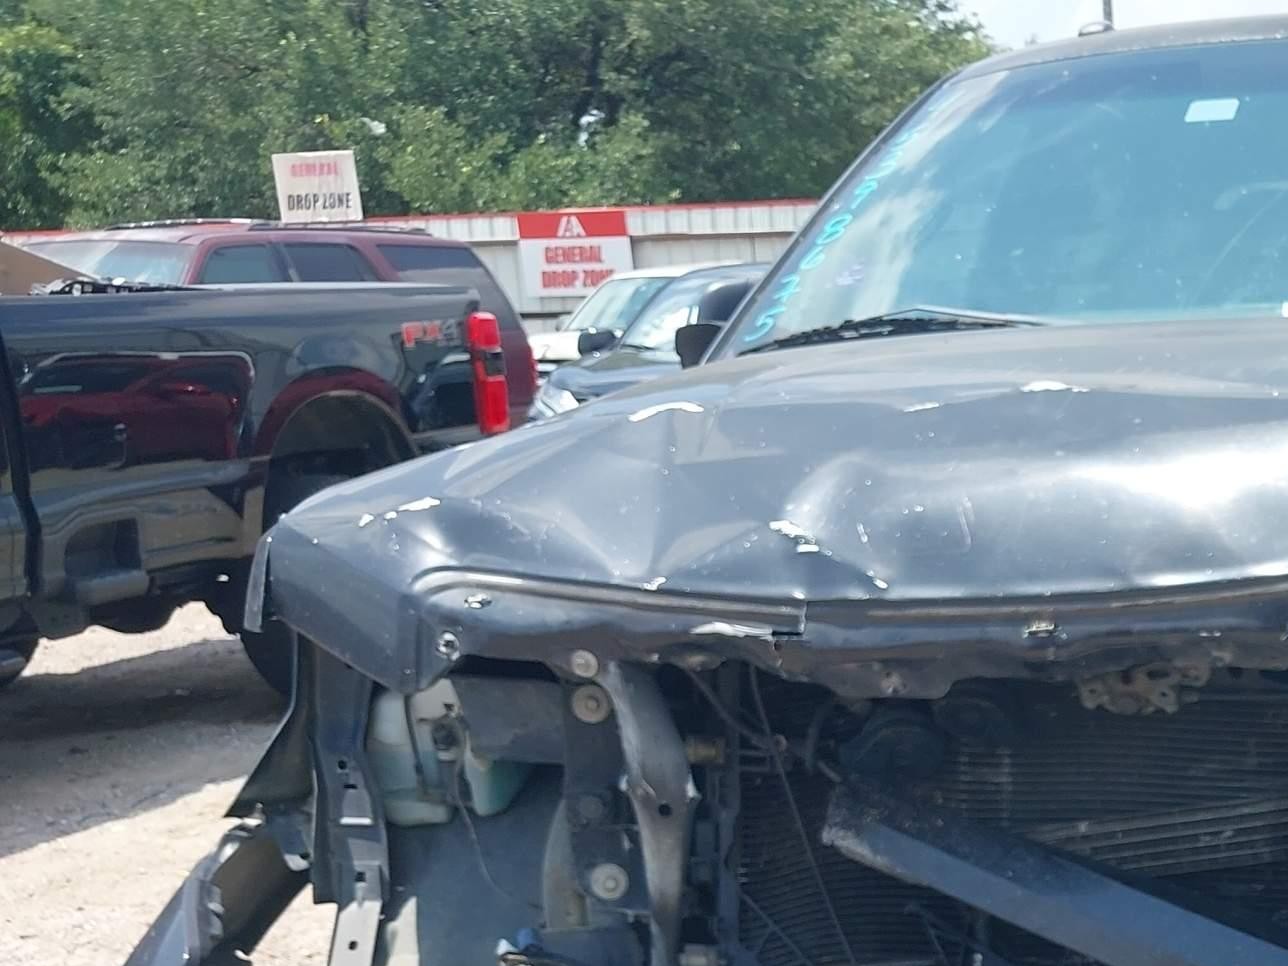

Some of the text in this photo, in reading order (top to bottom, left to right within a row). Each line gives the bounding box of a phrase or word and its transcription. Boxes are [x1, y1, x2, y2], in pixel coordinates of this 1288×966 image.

[287, 191, 352, 211] DROP ZONE
[544, 245, 604, 264] GENERAL
[541, 270, 577, 288] DROP
[401, 319, 460, 348] FX4
